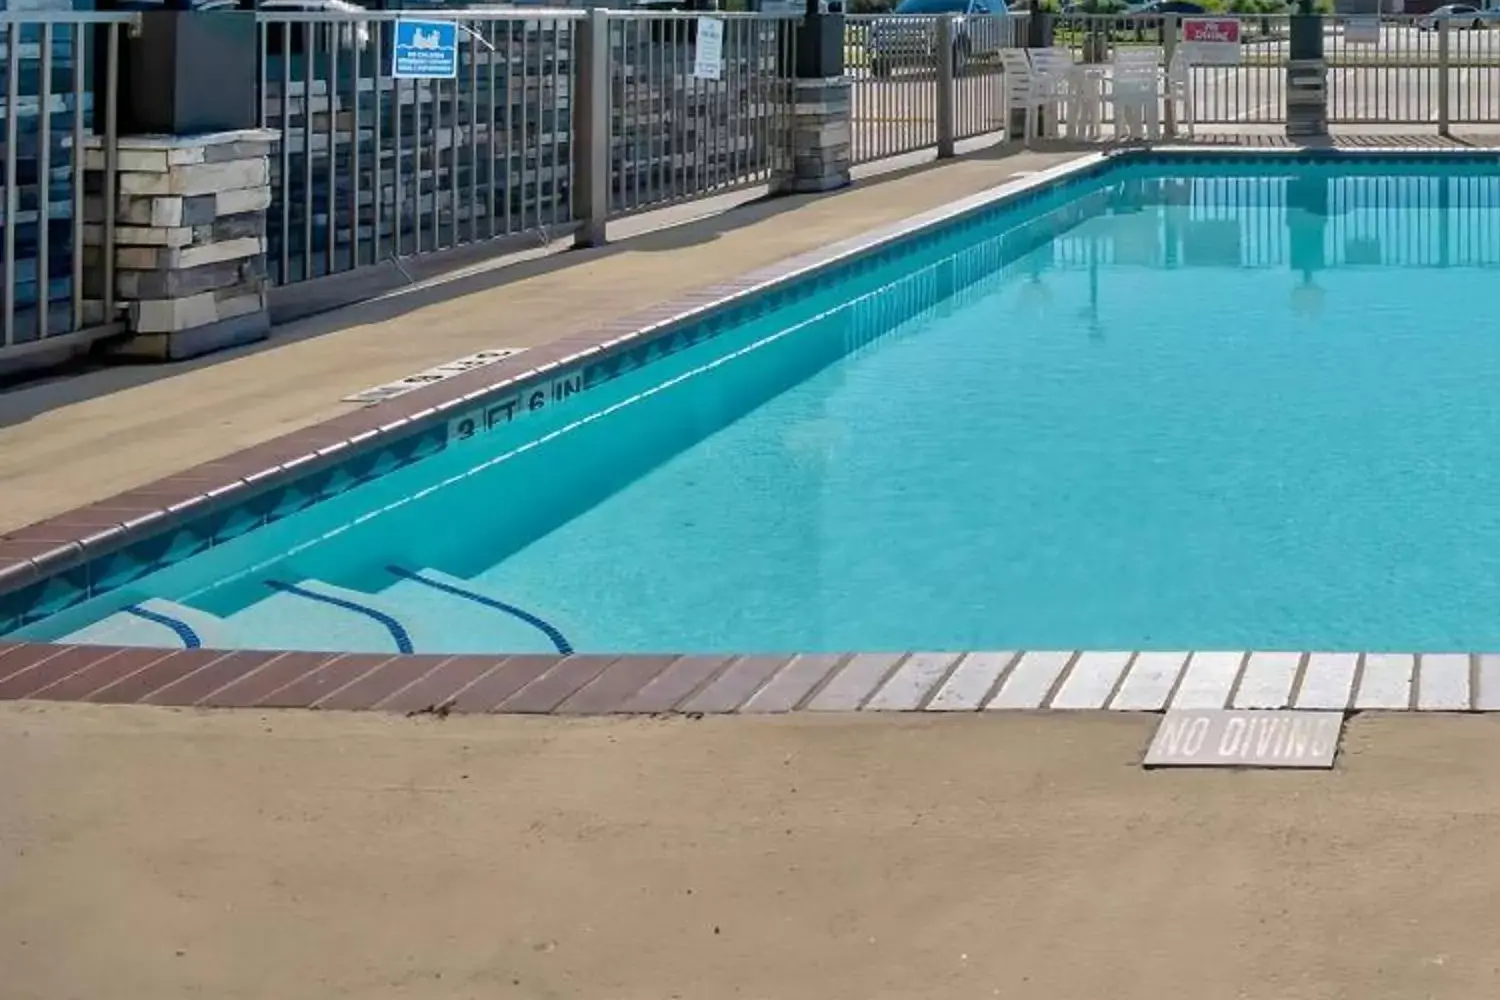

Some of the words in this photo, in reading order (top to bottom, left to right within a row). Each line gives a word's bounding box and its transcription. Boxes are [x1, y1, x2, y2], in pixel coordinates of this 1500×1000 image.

[486, 403, 515, 430] FT
[527, 390, 546, 411] 6
[555, 374, 582, 402] IN
[1157, 716, 1211, 757] NO
[1218, 717, 1331, 758] DIVING
